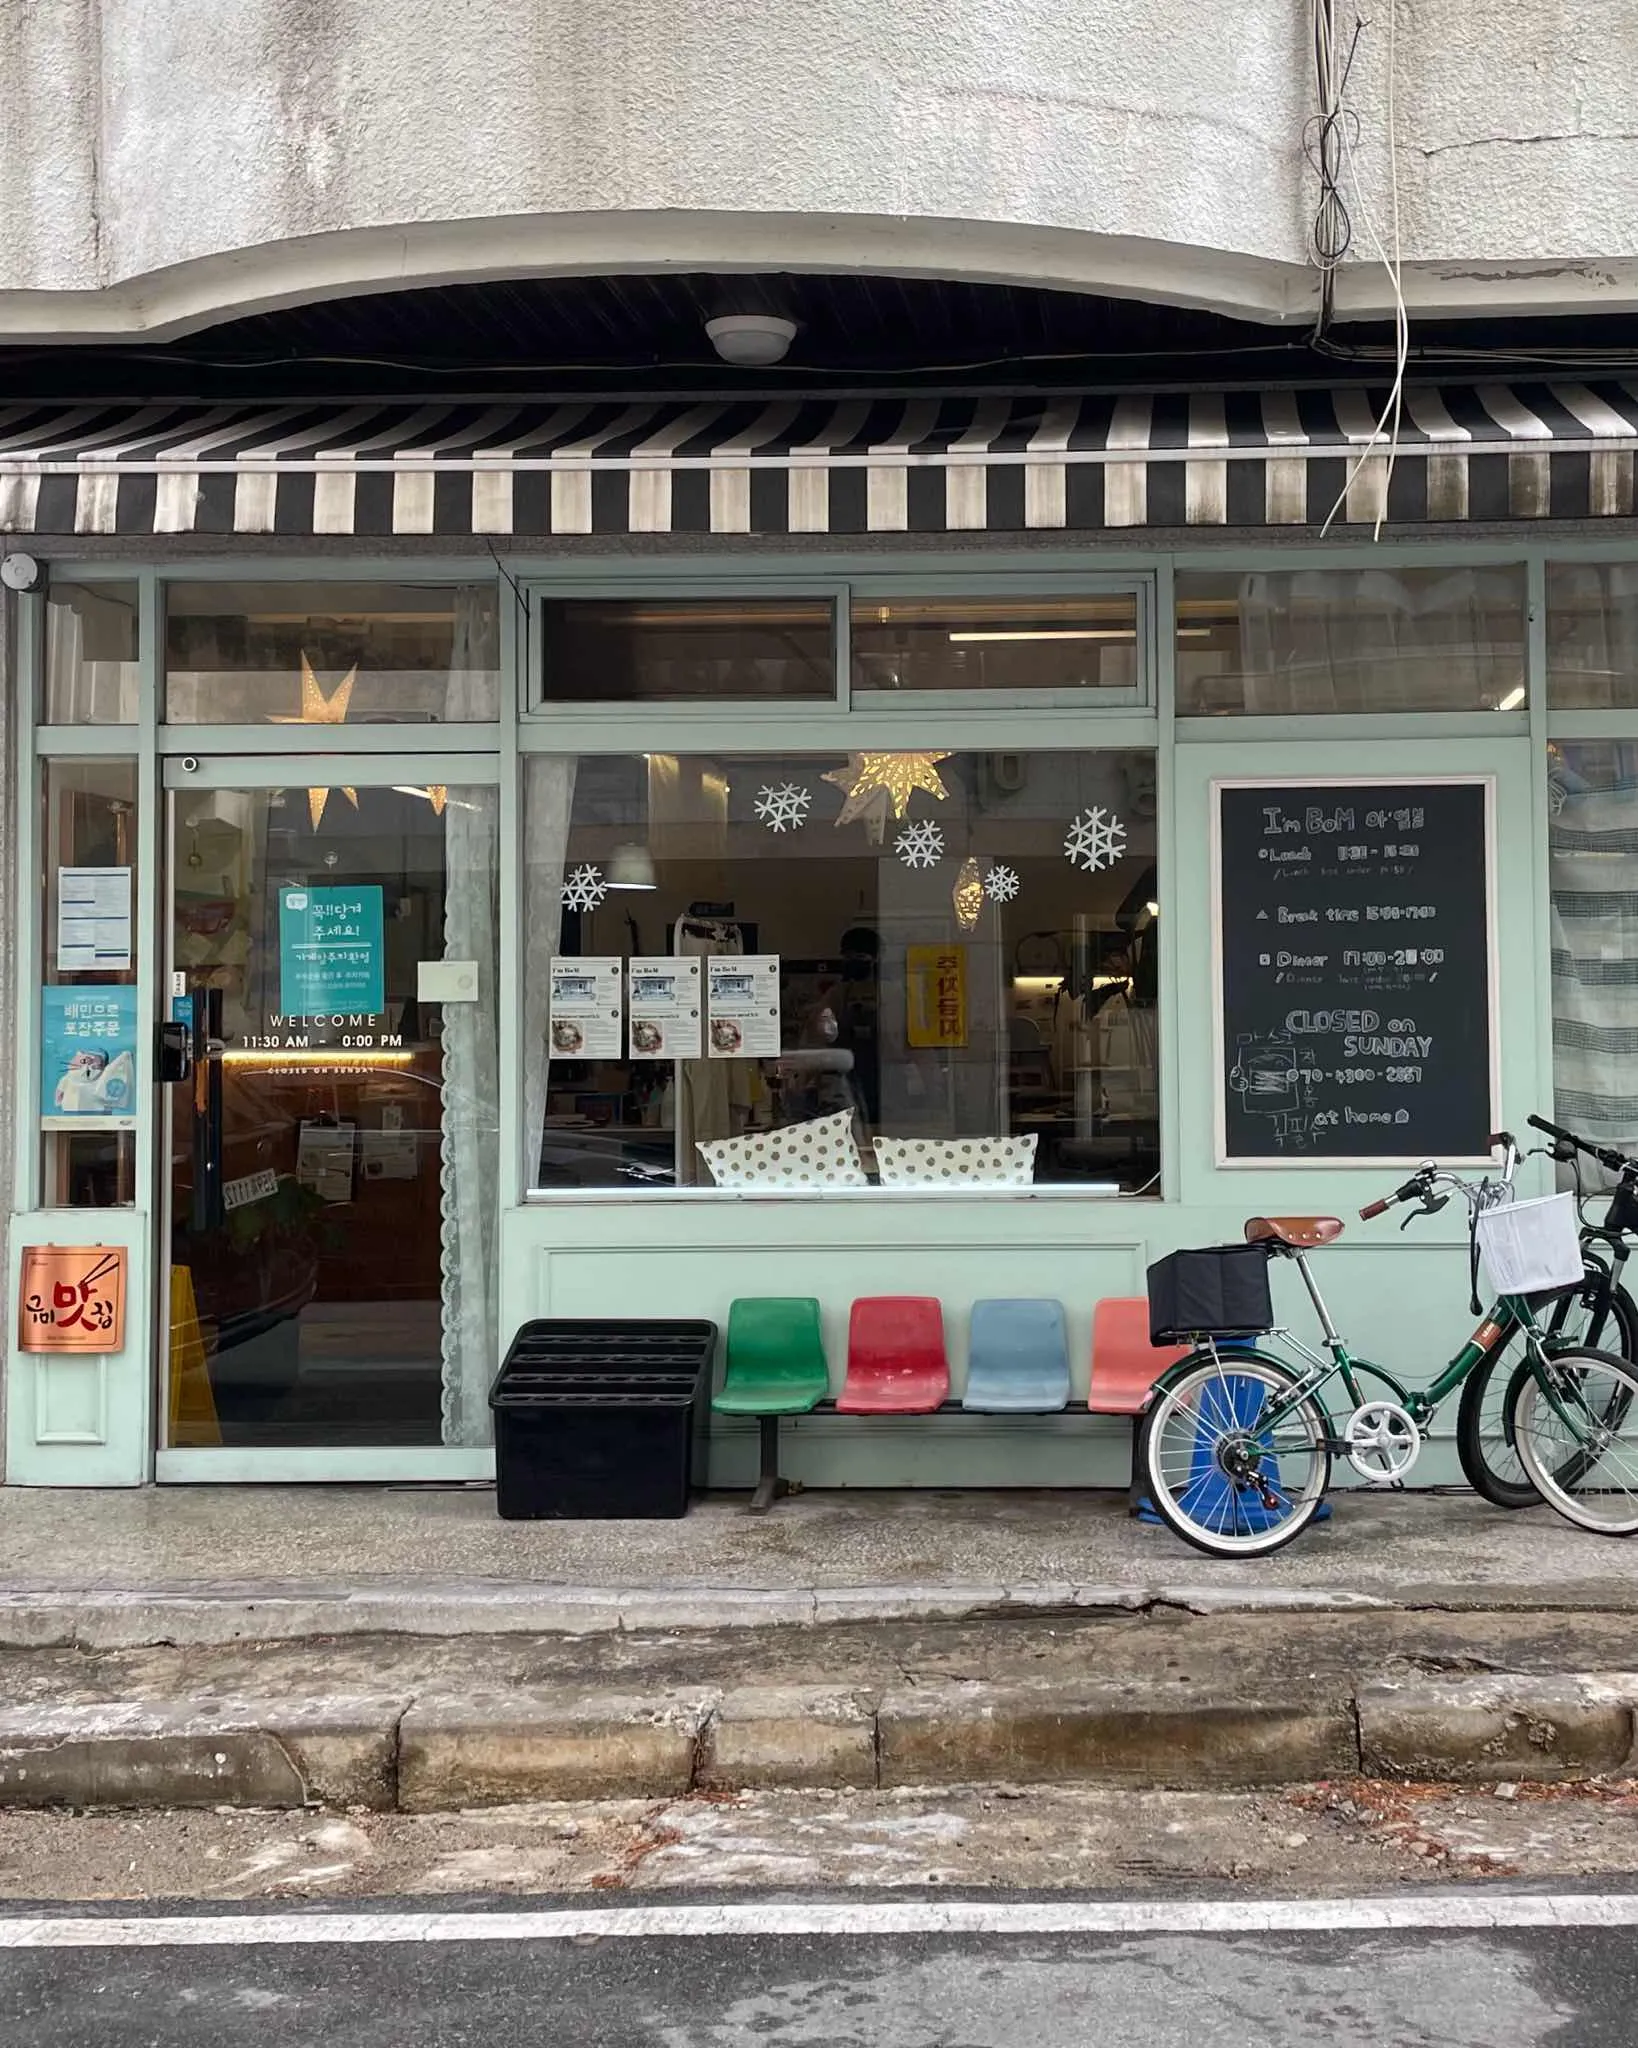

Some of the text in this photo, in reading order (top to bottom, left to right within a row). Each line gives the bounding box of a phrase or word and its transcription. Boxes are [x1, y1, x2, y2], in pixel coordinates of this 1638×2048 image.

[1263, 807, 1300, 834] I'm
[1270, 846, 1311, 861] Lunch
[1278, 906, 1318, 923] Break
[1325, 908, 1359, 922] time
[1277, 951, 1328, 967] Dinner
[64, 1004, 119, 1019] 배민으로
[270, 1014, 376, 1027] WELCOME
[1285, 1009, 1416, 1034] CLOSED on
[64, 1021, 120, 1037] 포장주문
[243, 1035, 279, 1048] 11:30
[285, 1036, 308, 1048] AM
[380, 1035, 402, 1047] PM
[1344, 1036, 1433, 1058] SUNDAY
[1314, 1106, 1392, 1125] at home
